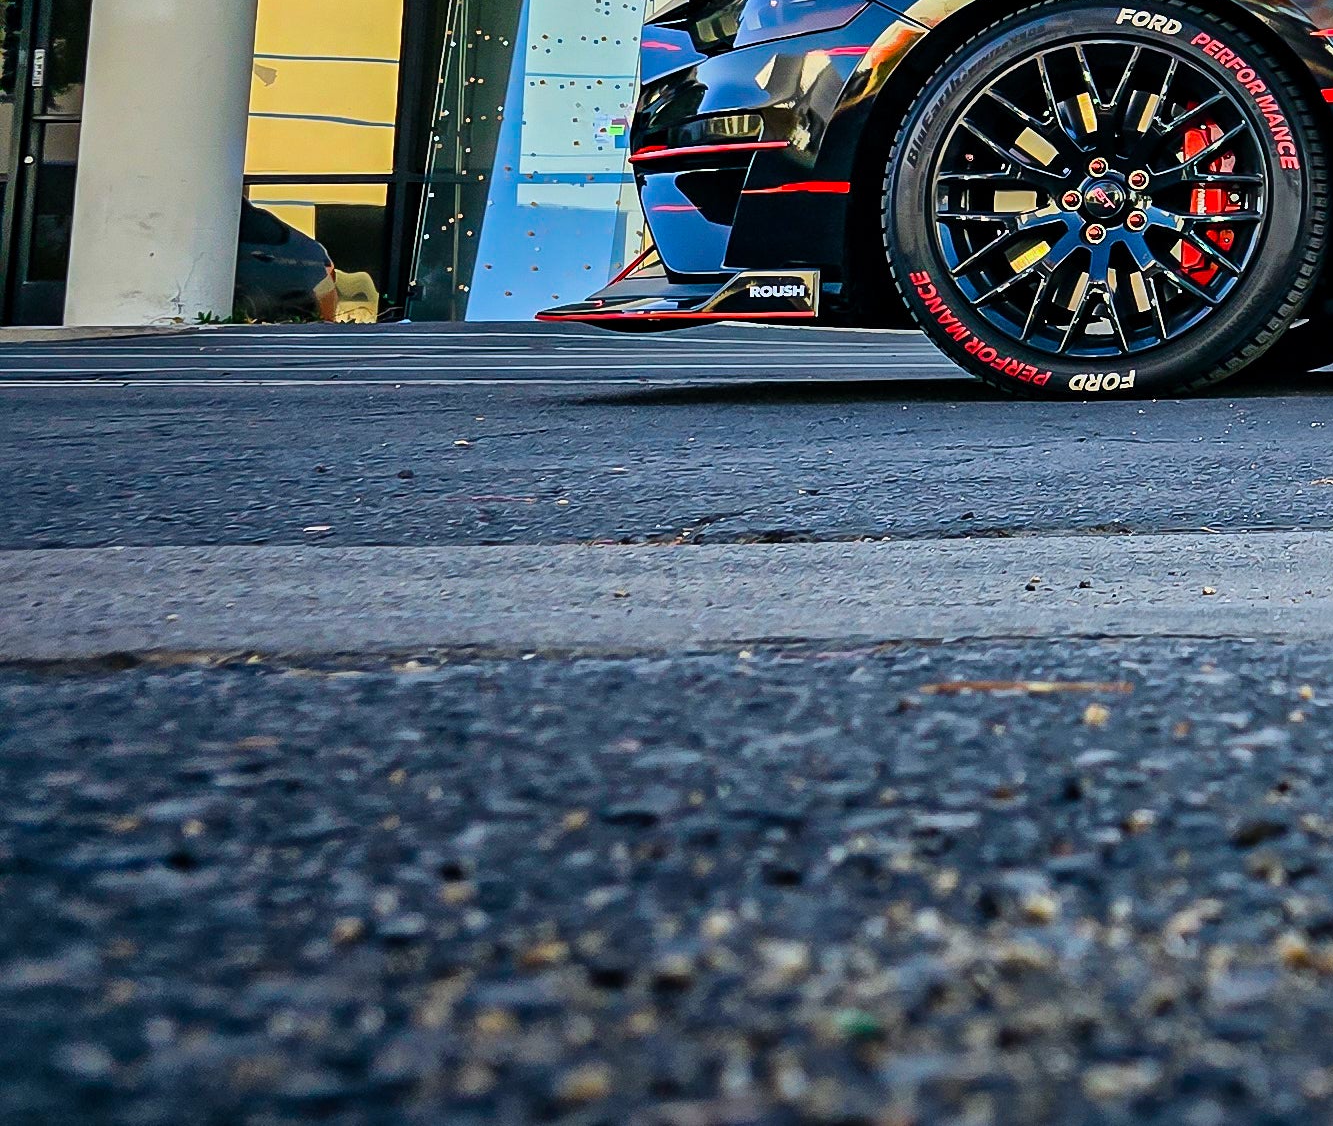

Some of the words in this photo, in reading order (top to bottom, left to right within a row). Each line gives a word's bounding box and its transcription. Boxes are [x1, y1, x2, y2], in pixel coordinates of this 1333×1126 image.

[1115, 7, 1183, 36] FORD
[1190, 31, 1301, 171] PERFORMANCE
[749, 284, 806, 298] ROUSH
[909, 269, 1053, 387] PERFORMANCE
[1068, 369, 1137, 392] FORD
